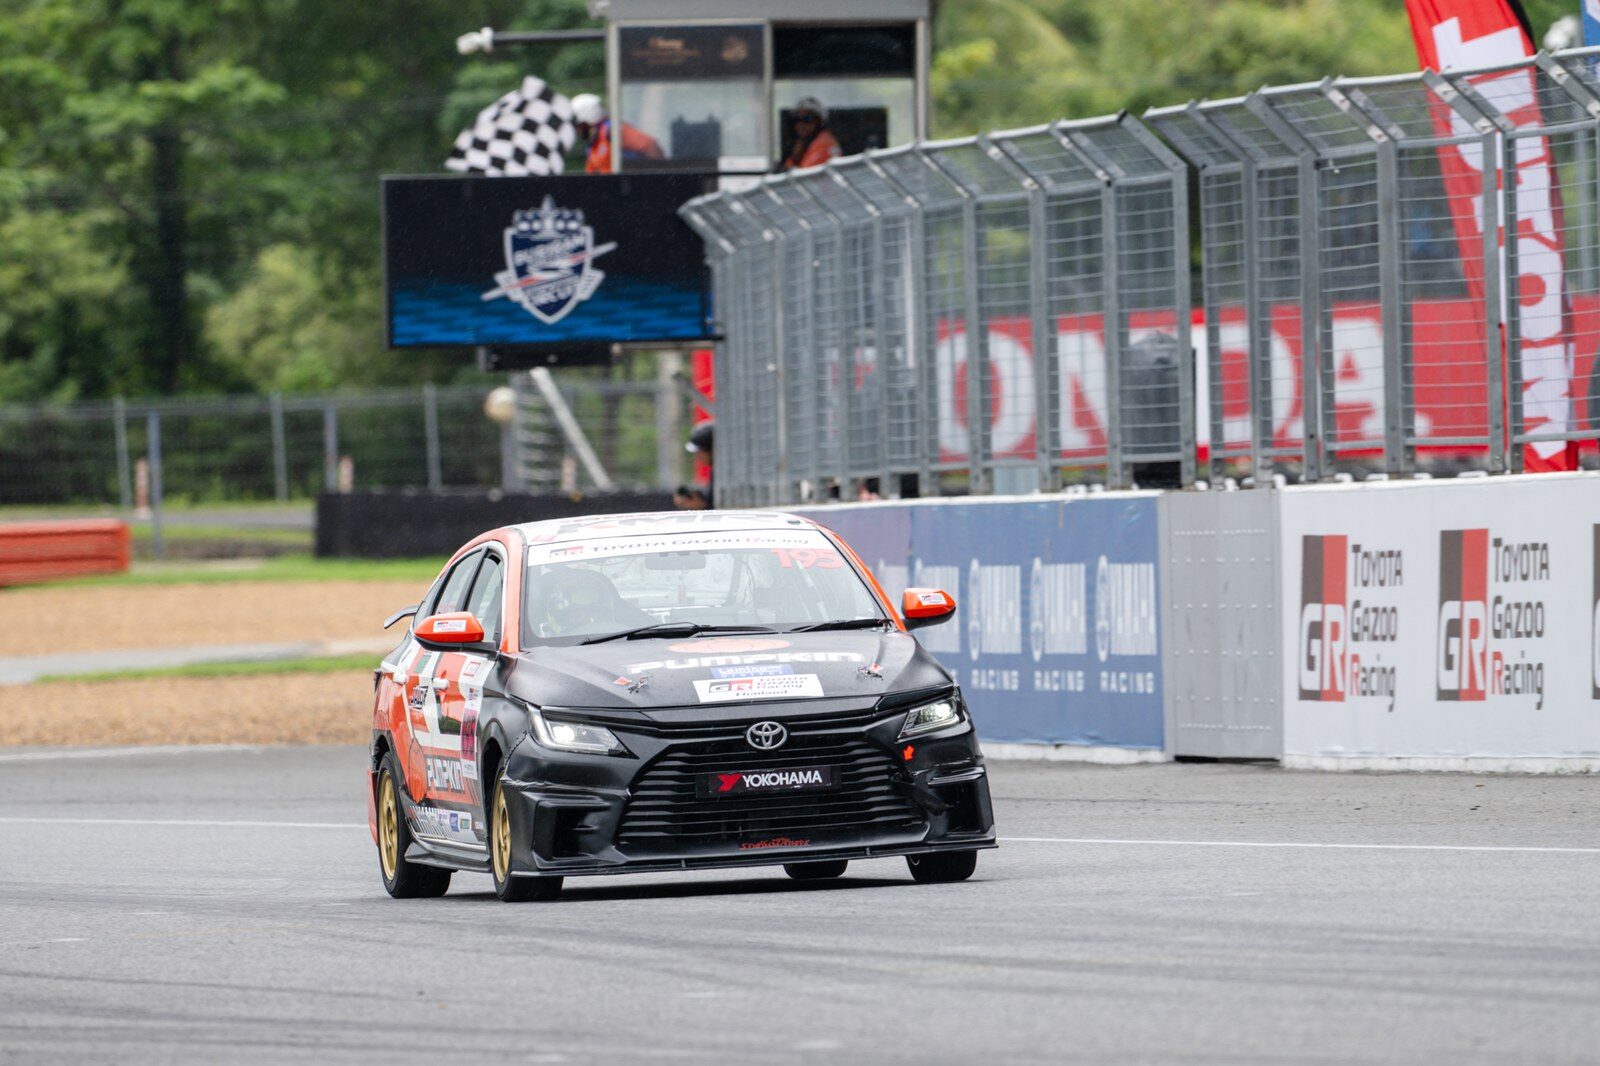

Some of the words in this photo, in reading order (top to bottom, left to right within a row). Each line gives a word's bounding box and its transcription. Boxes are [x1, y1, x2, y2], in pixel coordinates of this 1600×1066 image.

[936, 318, 1432, 453] ONDA
[593, 541, 666, 552] TOYOTA
[671, 538, 741, 547] GAZOO
[745, 536, 809, 545] Racing
[771, 548, 845, 570] 195
[1492, 537, 1550, 583] TOYOTA
[1351, 544, 1403, 588] TOYOTA
[1351, 600, 1397, 642] GAZOO
[1491, 595, 1545, 640] GAZOO
[621, 651, 866, 675] PUMPKIN
[1300, 602, 1346, 692] GR
[1437, 600, 1488, 692] GR
[970, 668, 1019, 692] RACING
[1033, 669, 1084, 693] RACING
[1099, 670, 1155, 694] RACING
[1350, 652, 1396, 713] Racing
[1491, 650, 1545, 711] Racing
[742, 770, 823, 788] YOKOHAMA
